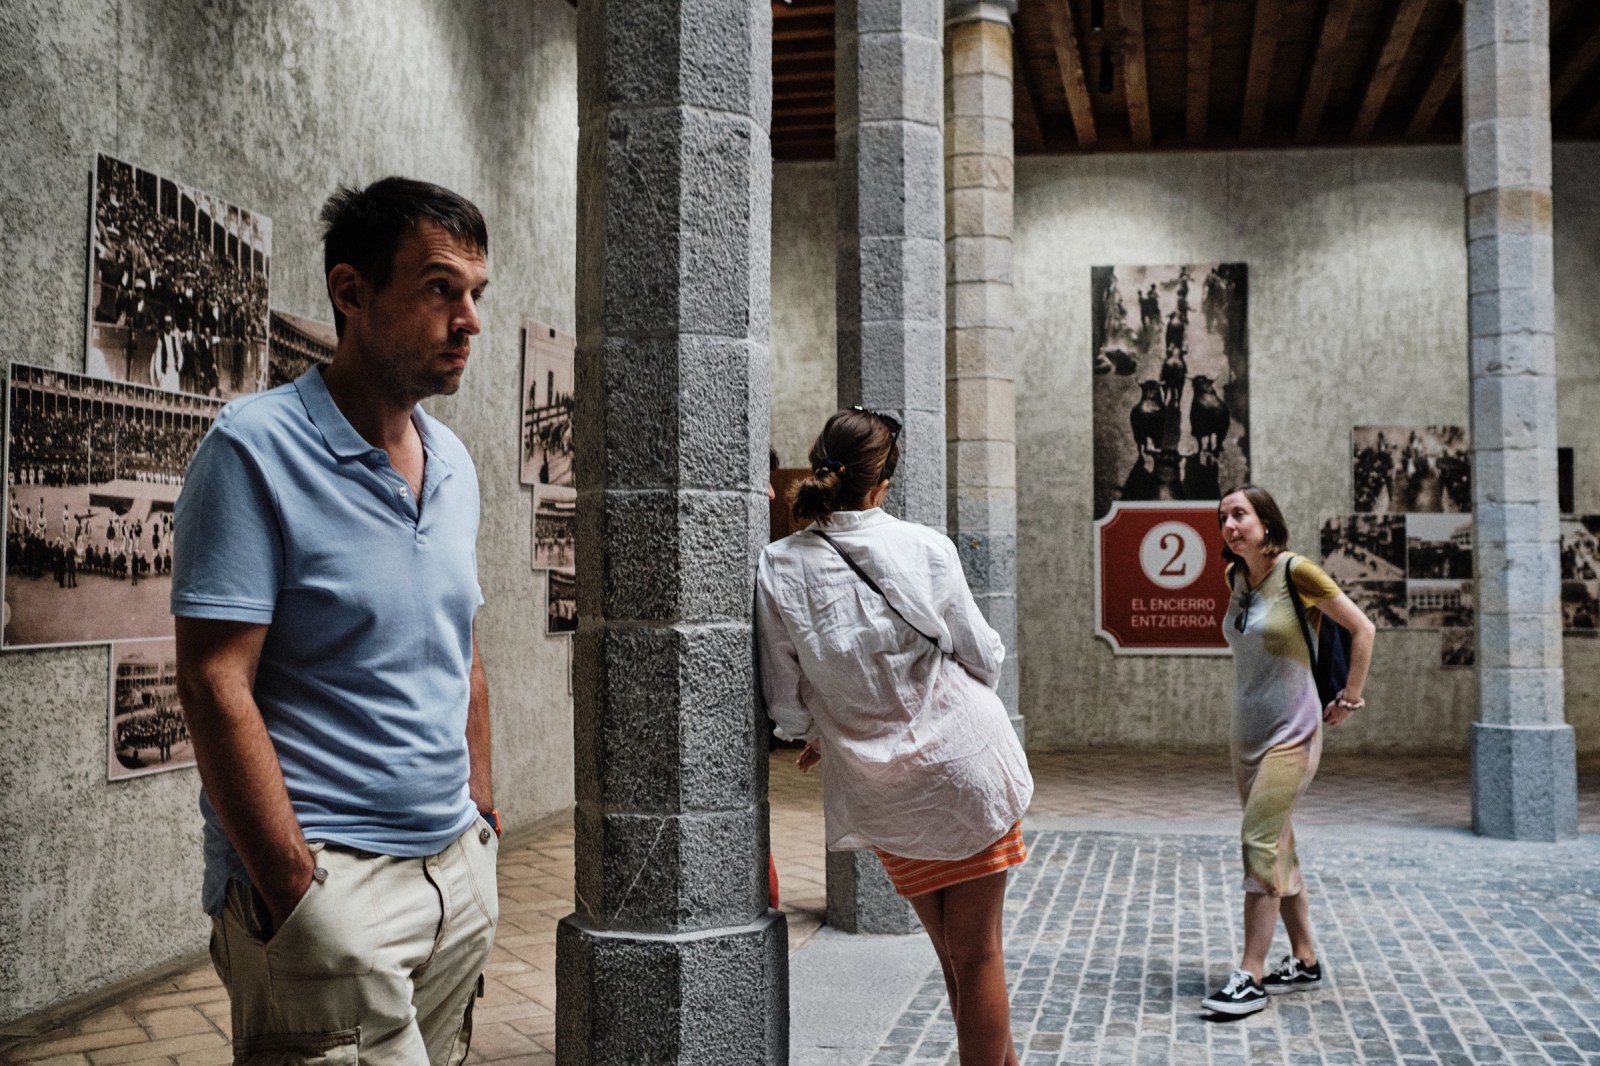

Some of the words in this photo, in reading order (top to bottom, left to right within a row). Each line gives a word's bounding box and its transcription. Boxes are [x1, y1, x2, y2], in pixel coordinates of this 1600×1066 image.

[1159, 532, 1187, 576] 2
[1131, 598, 1147, 611] EL
[1150, 598, 1216, 611] ENCIERRO
[1131, 615, 1217, 628] ENTZIERROA
